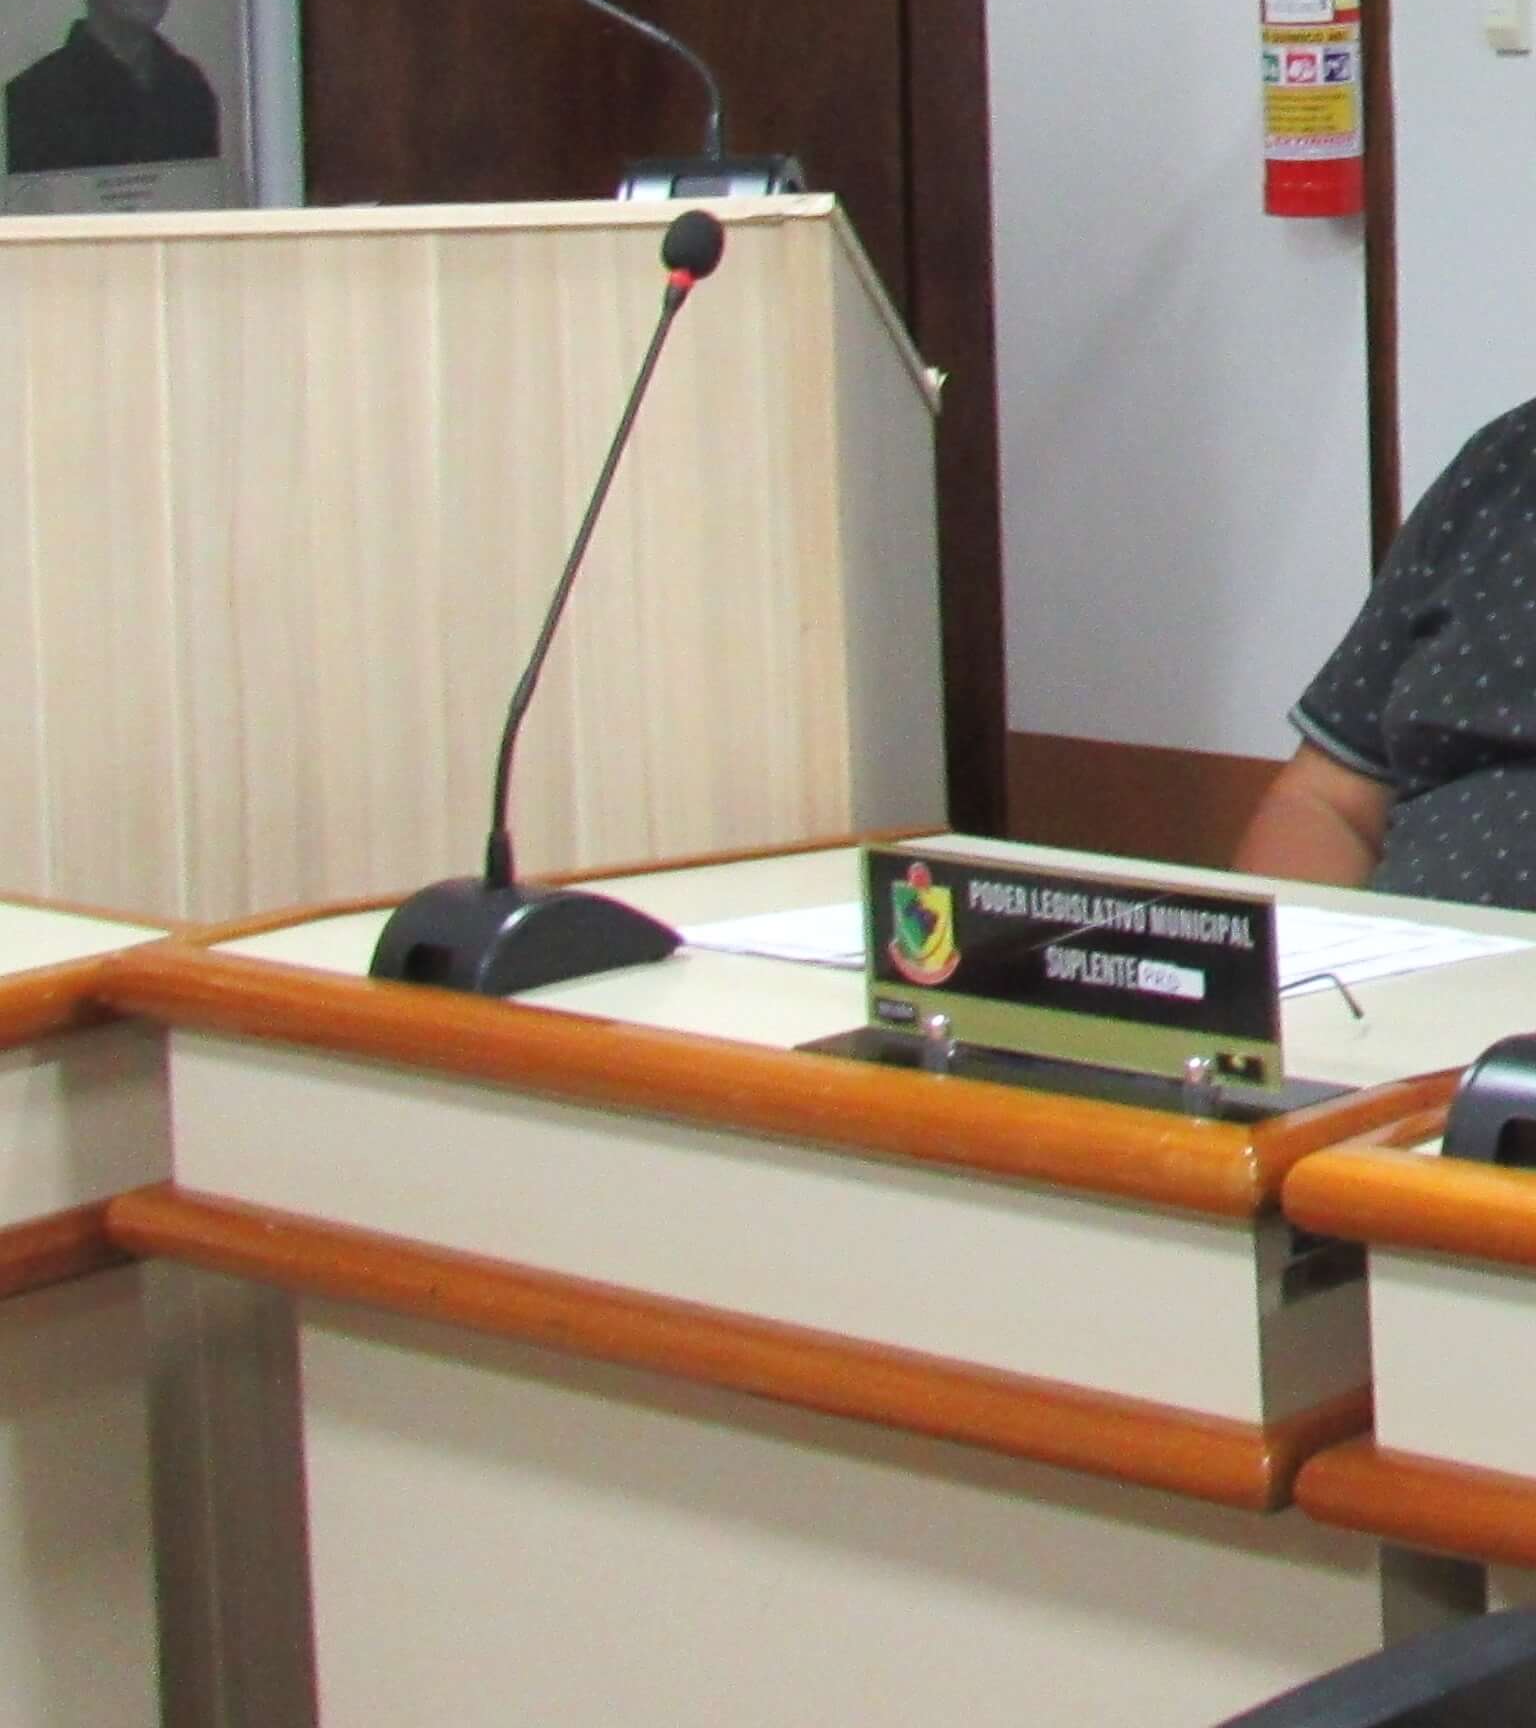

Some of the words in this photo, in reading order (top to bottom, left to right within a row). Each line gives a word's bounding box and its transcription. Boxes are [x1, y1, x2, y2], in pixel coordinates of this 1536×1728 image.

[968, 880, 1027, 917] PODER
[1030, 887, 1147, 934] LEGISLATIVO
[1149, 905, 1254, 949] MUNICIPAL
[1044, 944, 1138, 990] SUPLENTE
